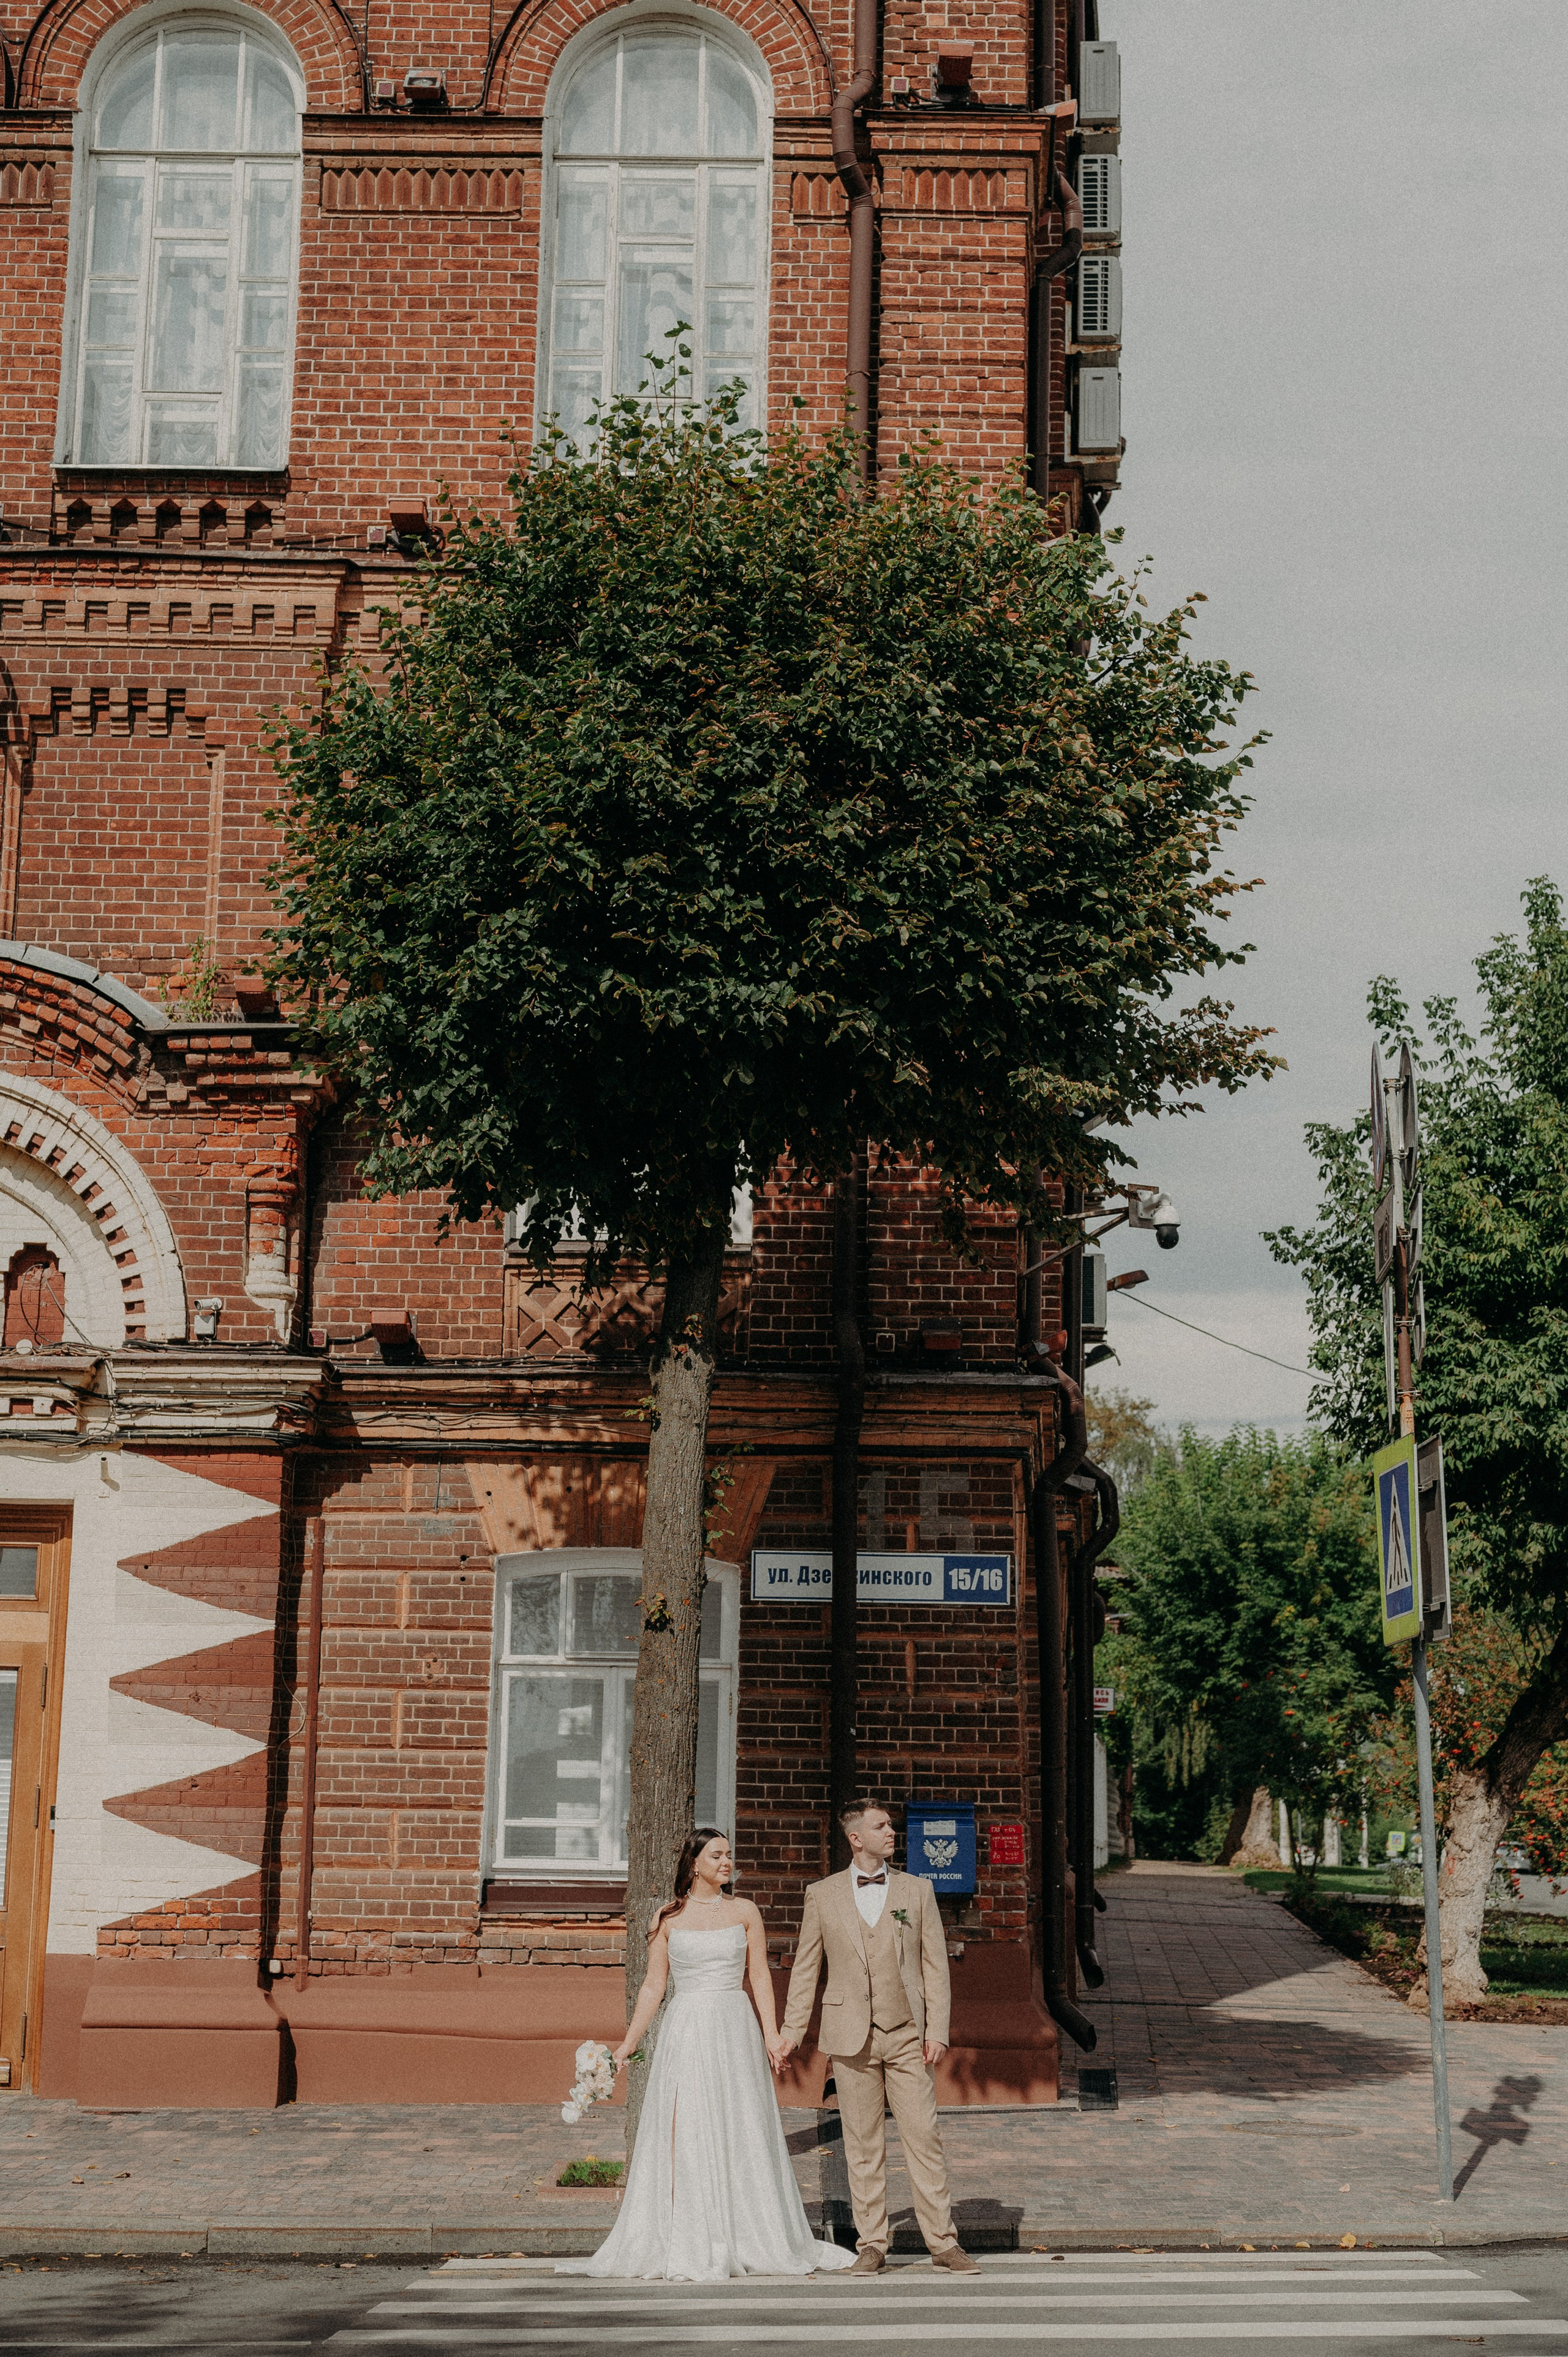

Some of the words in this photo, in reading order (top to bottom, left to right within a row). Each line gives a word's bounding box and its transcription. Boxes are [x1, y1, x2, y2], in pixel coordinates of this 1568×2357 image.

[767, 1567, 793, 1584] ул.
[797, 1565, 932, 1586] Дзеинского
[948, 1568, 1003, 1591] 15/16
